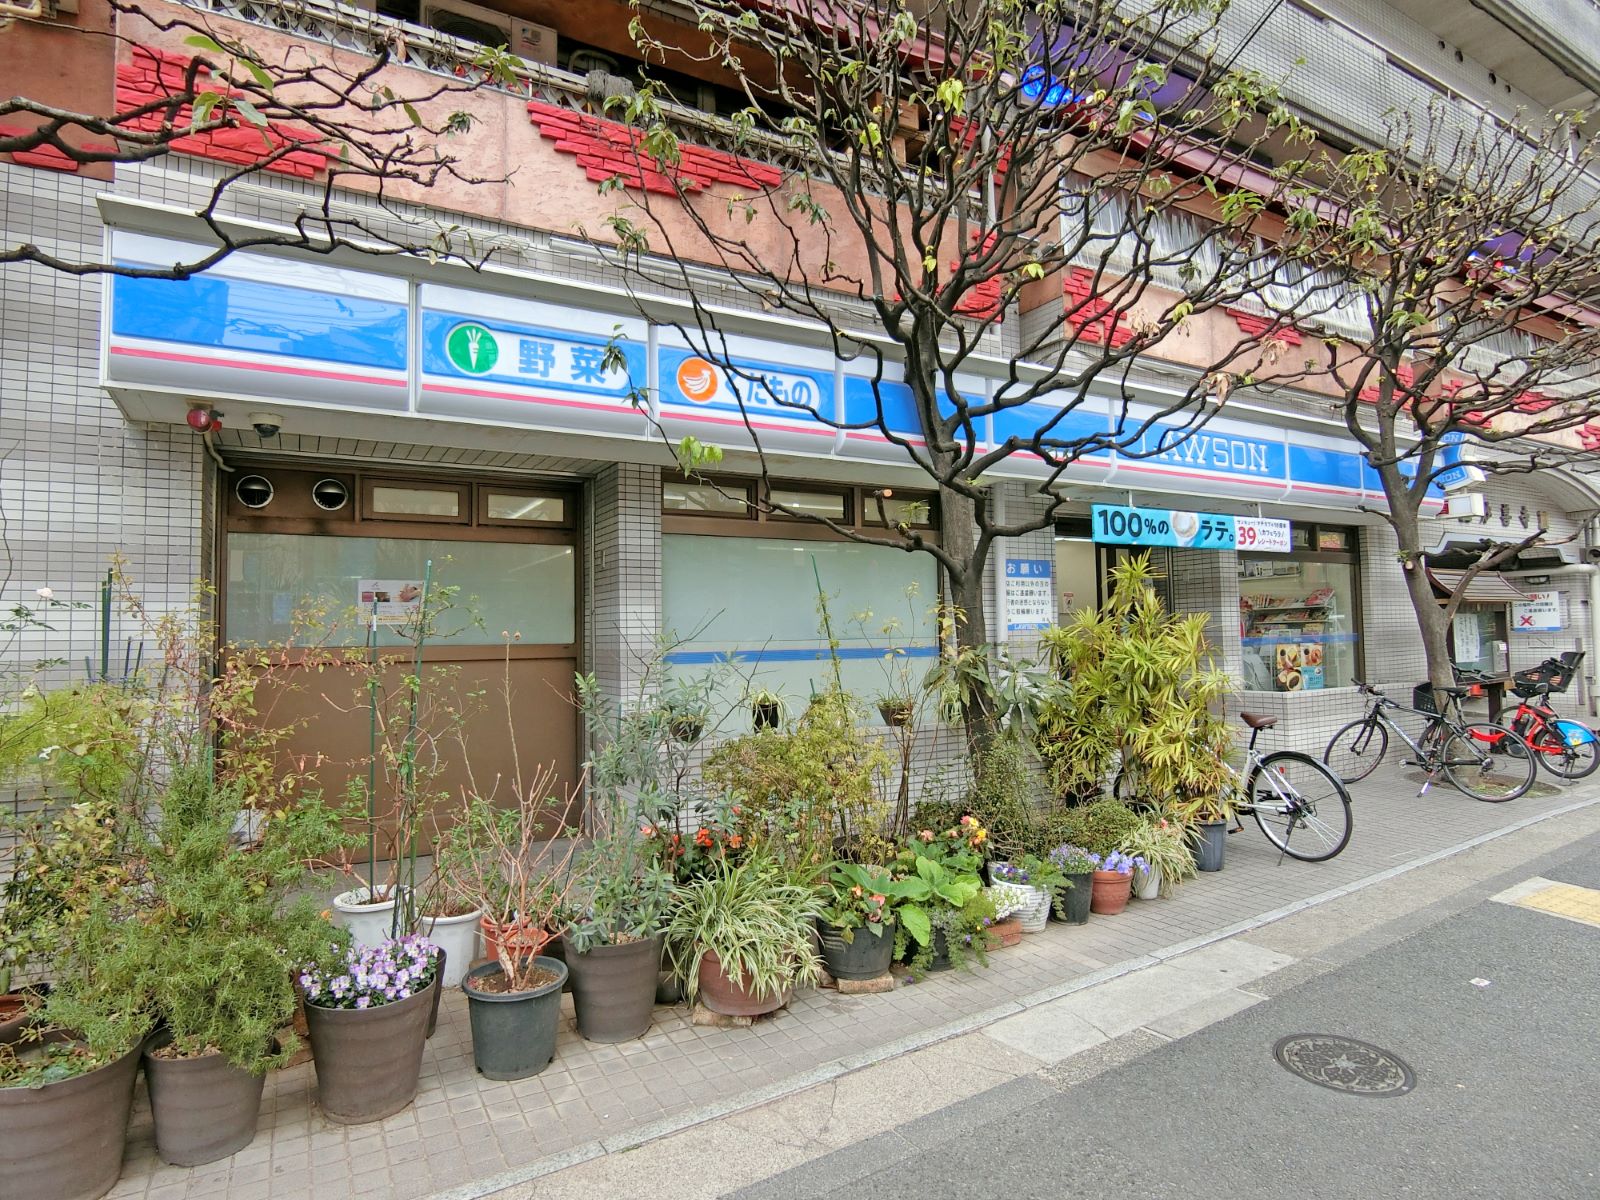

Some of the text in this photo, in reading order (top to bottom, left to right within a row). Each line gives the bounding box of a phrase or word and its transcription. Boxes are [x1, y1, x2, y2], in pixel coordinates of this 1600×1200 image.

[518, 339, 606, 384] 野菜
[724, 372, 812, 407] くだもの
[1137, 426, 1269, 473] LAWSON
[1097, 509, 1234, 543] 100%の ラテ。
[1237, 526, 1257, 546] 39
[1006, 562, 1043, 575] お願い
